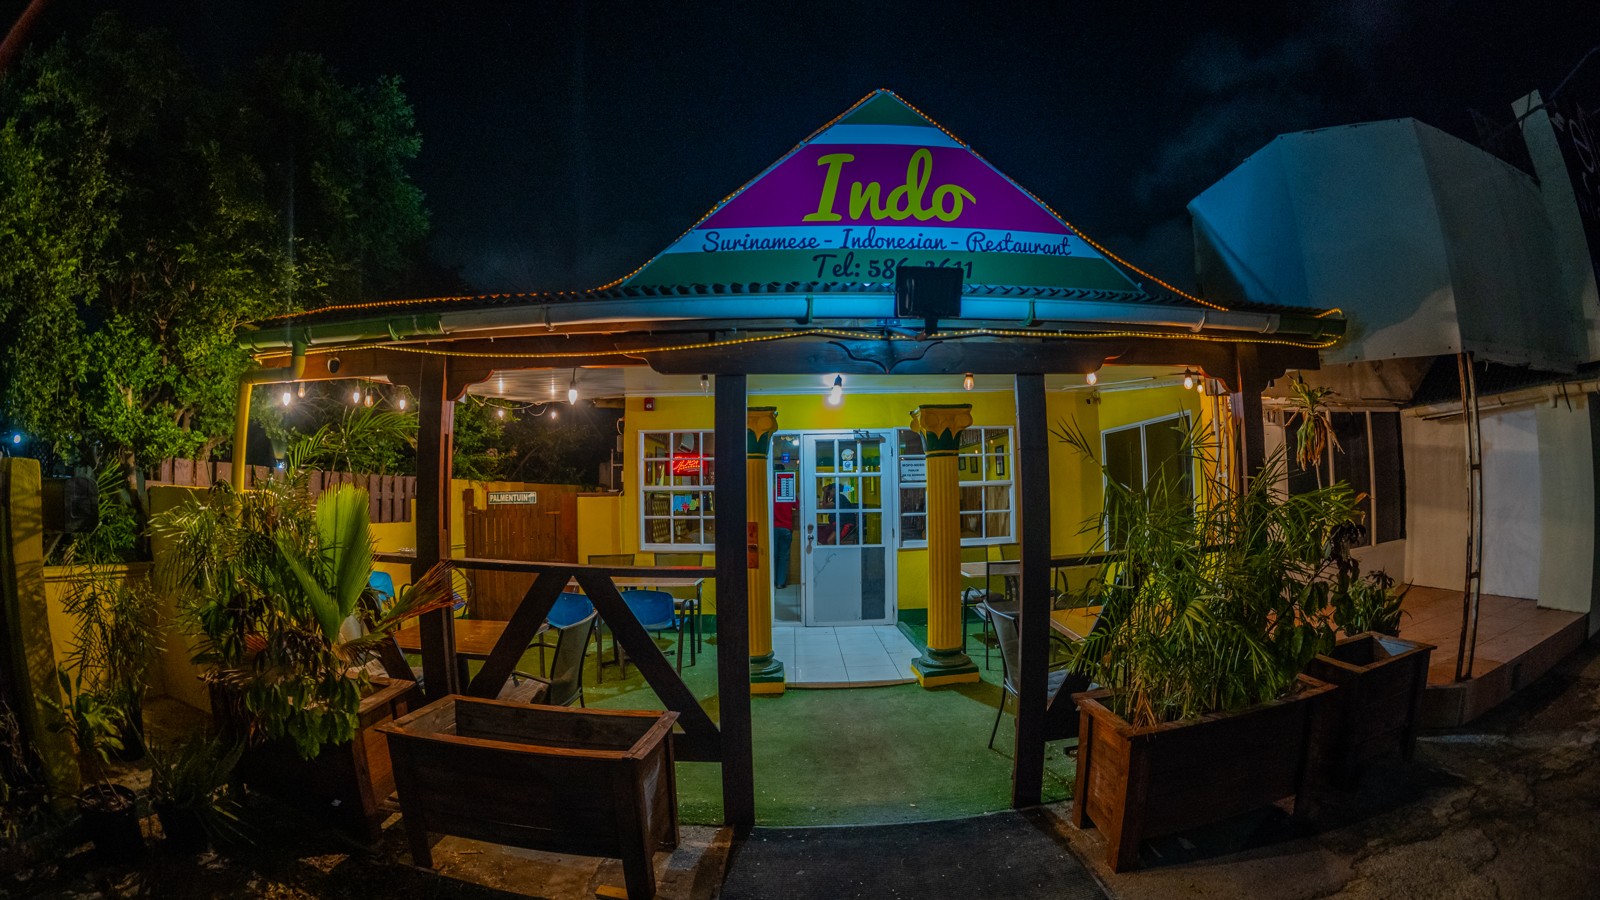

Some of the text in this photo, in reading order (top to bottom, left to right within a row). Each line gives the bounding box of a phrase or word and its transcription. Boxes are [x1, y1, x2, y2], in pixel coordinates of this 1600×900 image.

[802, 148, 977, 222] Indo
[702, 231, 820, 253] Surinamese
[839, 226, 947, 250] Indonesian
[966, 231, 1072, 256] Restaurant
[812, 251, 861, 279] Tel:
[490, 494, 527, 502] PALMENTUIN
